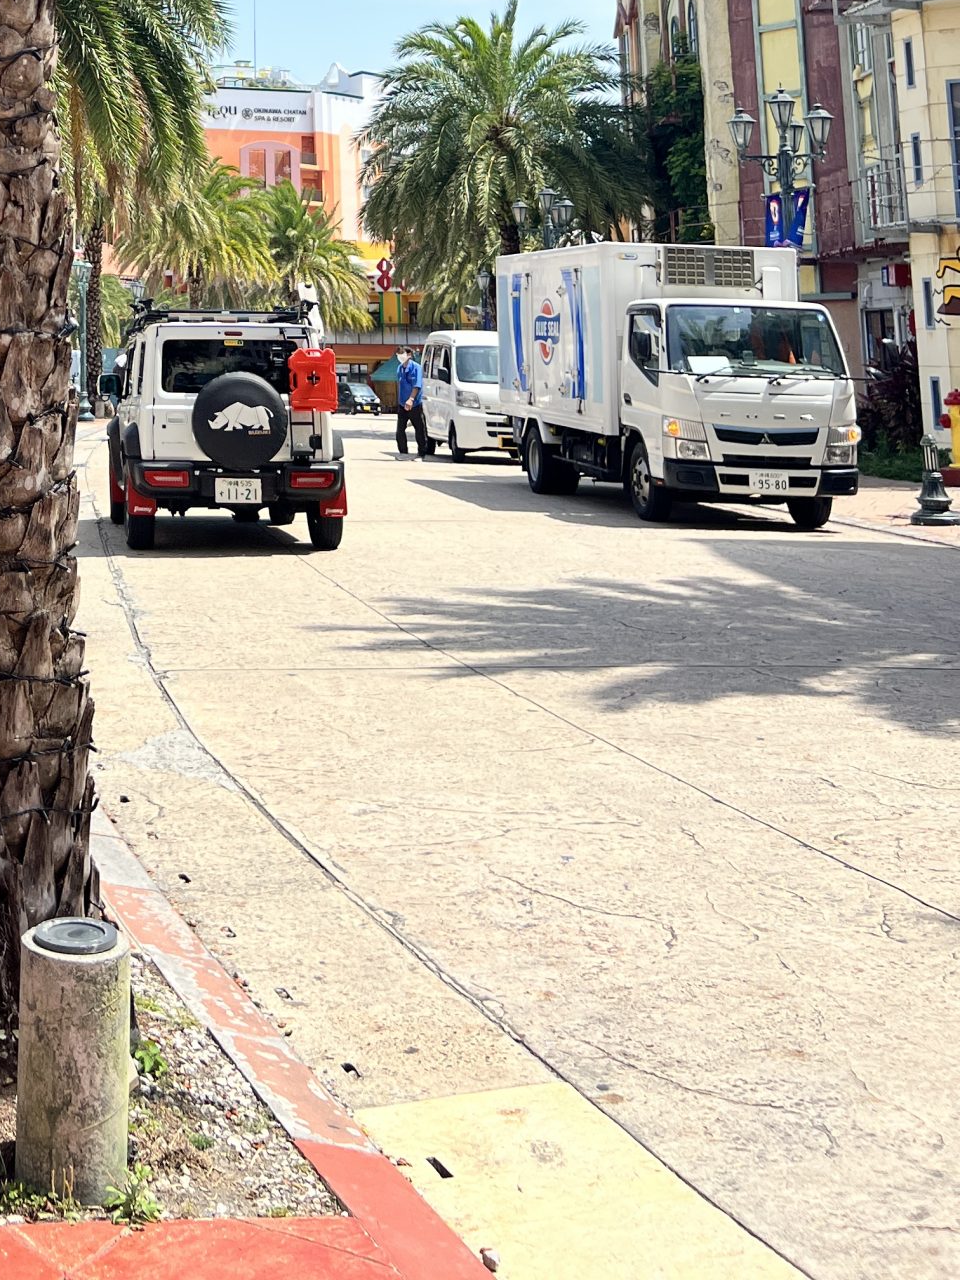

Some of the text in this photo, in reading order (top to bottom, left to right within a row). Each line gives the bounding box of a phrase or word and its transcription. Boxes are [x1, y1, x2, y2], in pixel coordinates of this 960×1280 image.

[283, 108, 307, 116] CHATAN
[536, 321, 559, 336] BLUE SEAL
[227, 487, 257, 500] 11-21
